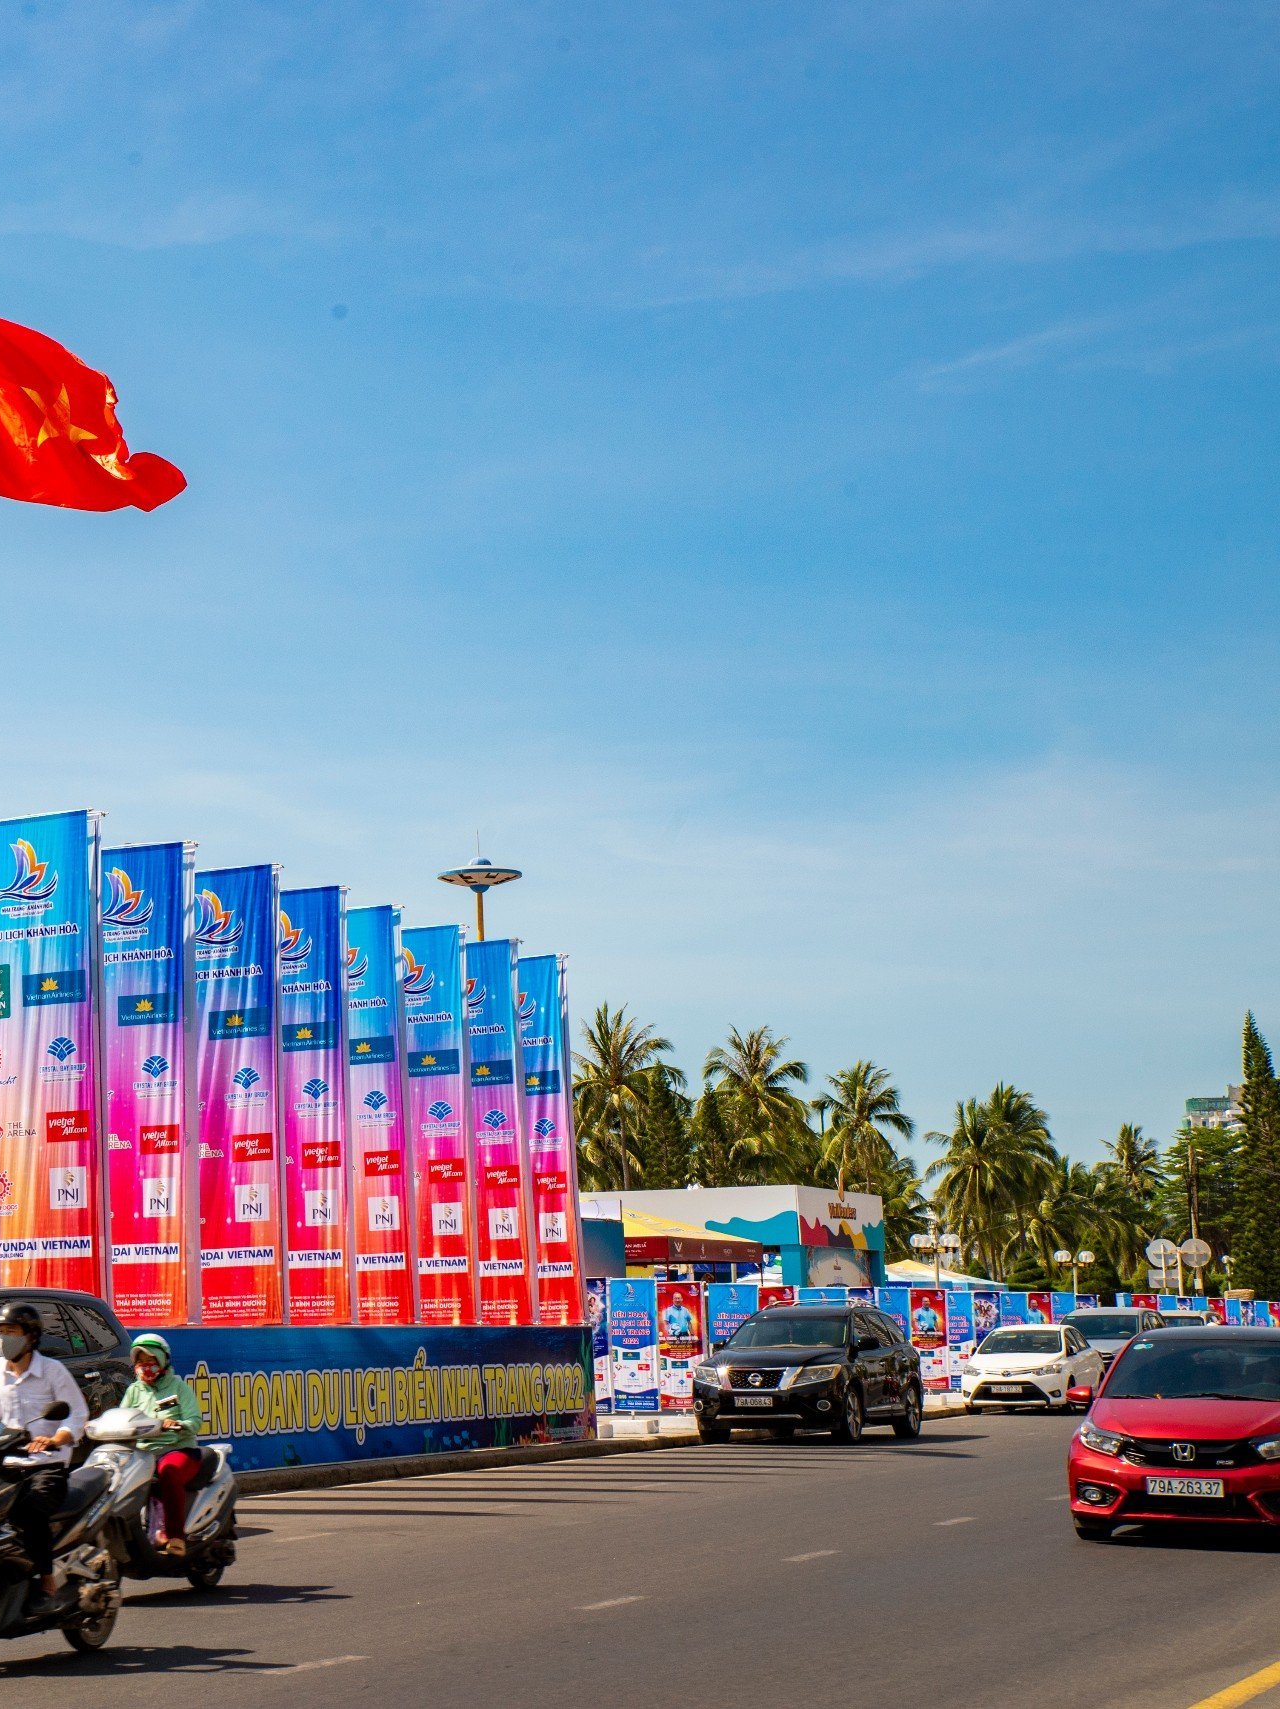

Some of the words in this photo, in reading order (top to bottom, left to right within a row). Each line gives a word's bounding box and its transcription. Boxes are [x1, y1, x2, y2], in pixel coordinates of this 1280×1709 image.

[6, 930, 24, 943] LỊCH
[26, 923, 56, 938] KHÁNH
[59, 921, 78, 935] HÒA
[104, 953, 119, 965] ỊCH
[121, 947, 152, 962] KHÁNH
[154, 945, 173, 959] HÒA
[213, 965, 242, 979] KHÁNH
[244, 963, 263, 976] HÒA
[282, 980, 311, 993] KHÁNH
[313, 978, 331, 991] HÒA
[370, 996, 387, 1007] HÒA
[408, 1012, 434, 1023] KHÁNH
[436, 1011, 452, 1021] HÒA
[489, 1023, 505, 1034] HÒA
[538, 1035, 553, 1046] HÒA
[7, 1122, 23, 1130] THE
[7, 1129, 37, 1137] ARENA
[57, 1188, 79, 1203] PNJ
[149, 1198, 169, 1212] PNJ
[242, 1203, 262, 1216] PNJ
[375, 1214, 394, 1226] PNJ
[438, 1219, 457, 1230] PNJ
[495, 1223, 512, 1234] PNJ
[41, 1239, 91, 1251] VIETNAM
[134, 1246, 179, 1256] VIETNAM
[228, 1249, 273, 1259] VIETNAM
[297, 1251, 341, 1262] VIETNAM
[362, 1255, 404, 1264] VIETNAM
[426, 1258, 467, 1268] VIETNAM
[483, 1262, 523, 1270] VIETNAM
[233, 1373, 303, 1433] HOAN
[307, 1372, 340, 1429] DU
[344, 1369, 391, 1442] LỊCH
[394, 1348, 439, 1422] BIỂN
[443, 1367, 484, 1418] NHA
[484, 1365, 544, 1414] TRANG
[544, 1366, 585, 1412] 2022
[1149, 1479, 1221, 1496] 79A-263.37
